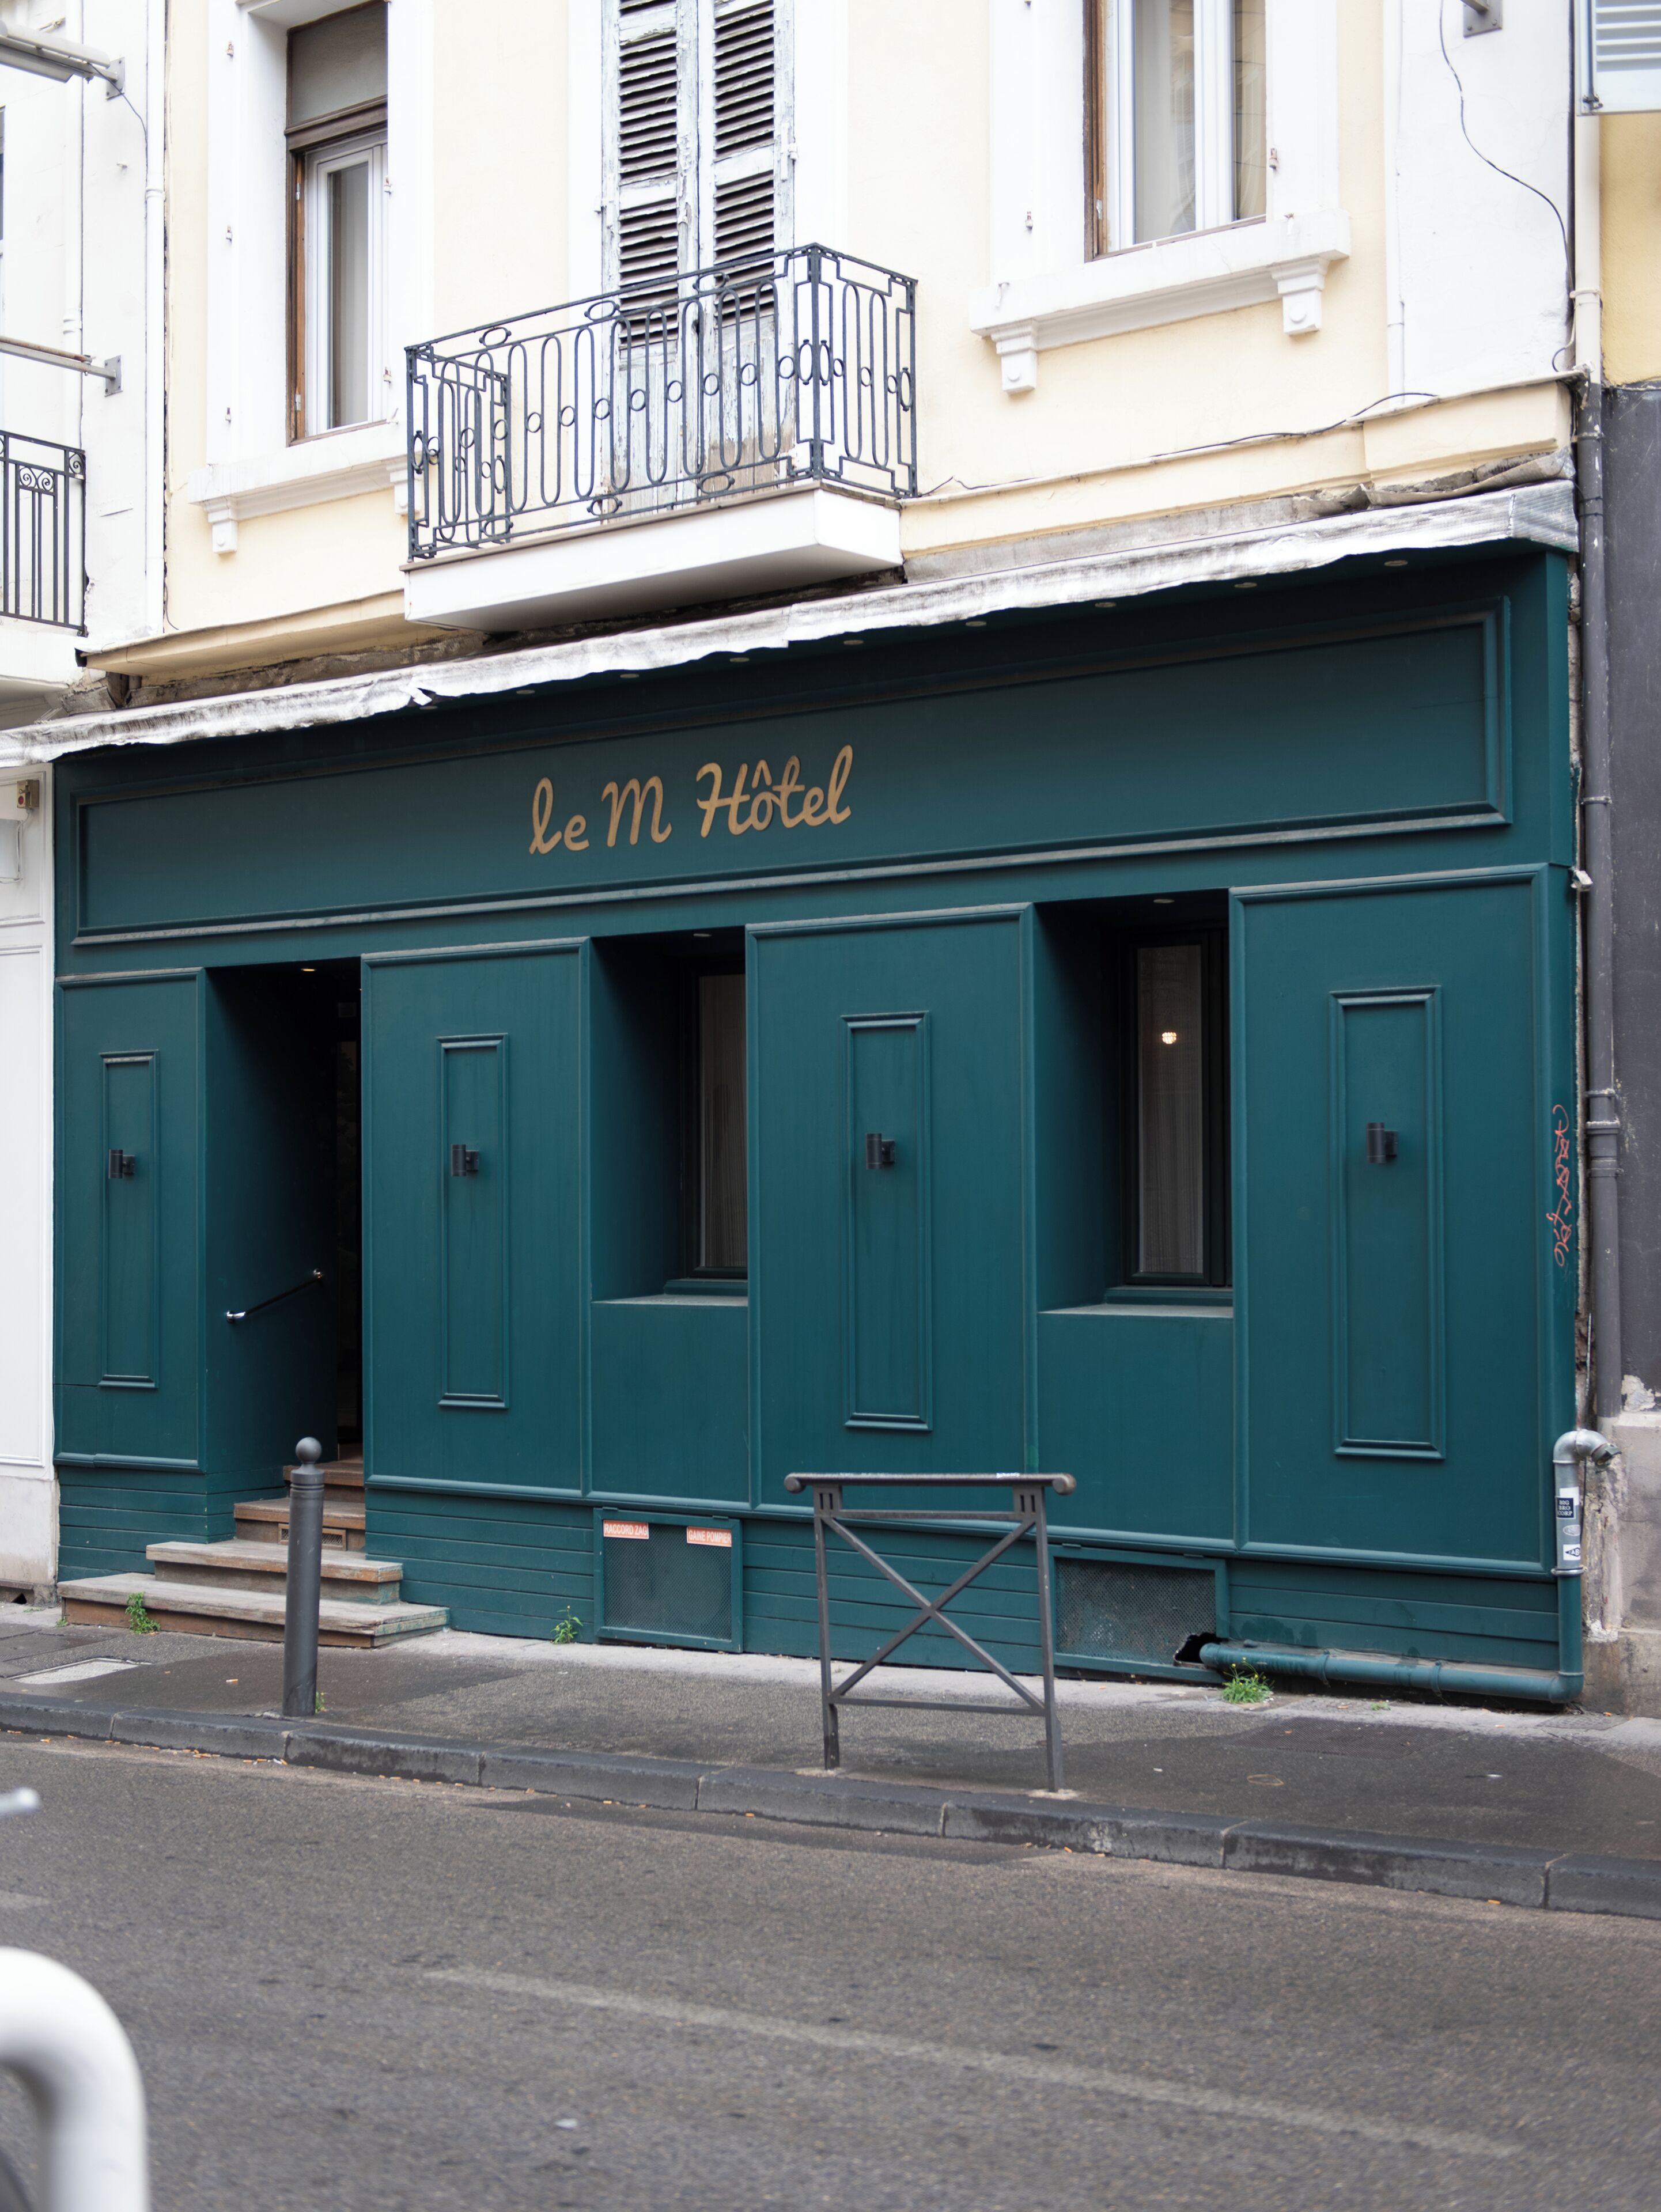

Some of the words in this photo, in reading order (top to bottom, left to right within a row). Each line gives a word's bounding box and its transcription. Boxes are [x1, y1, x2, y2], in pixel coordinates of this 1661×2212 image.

[529, 777, 590, 855] le
[601, 775, 672, 848] M
[696, 744, 853, 838] Hôtel
[605, 1523, 633, 1535] RACCORD
[635, 1525, 647, 1536] ZAG
[688, 1530, 706, 1542] GAINE
[707, 1532, 732, 1544] POMPIER
